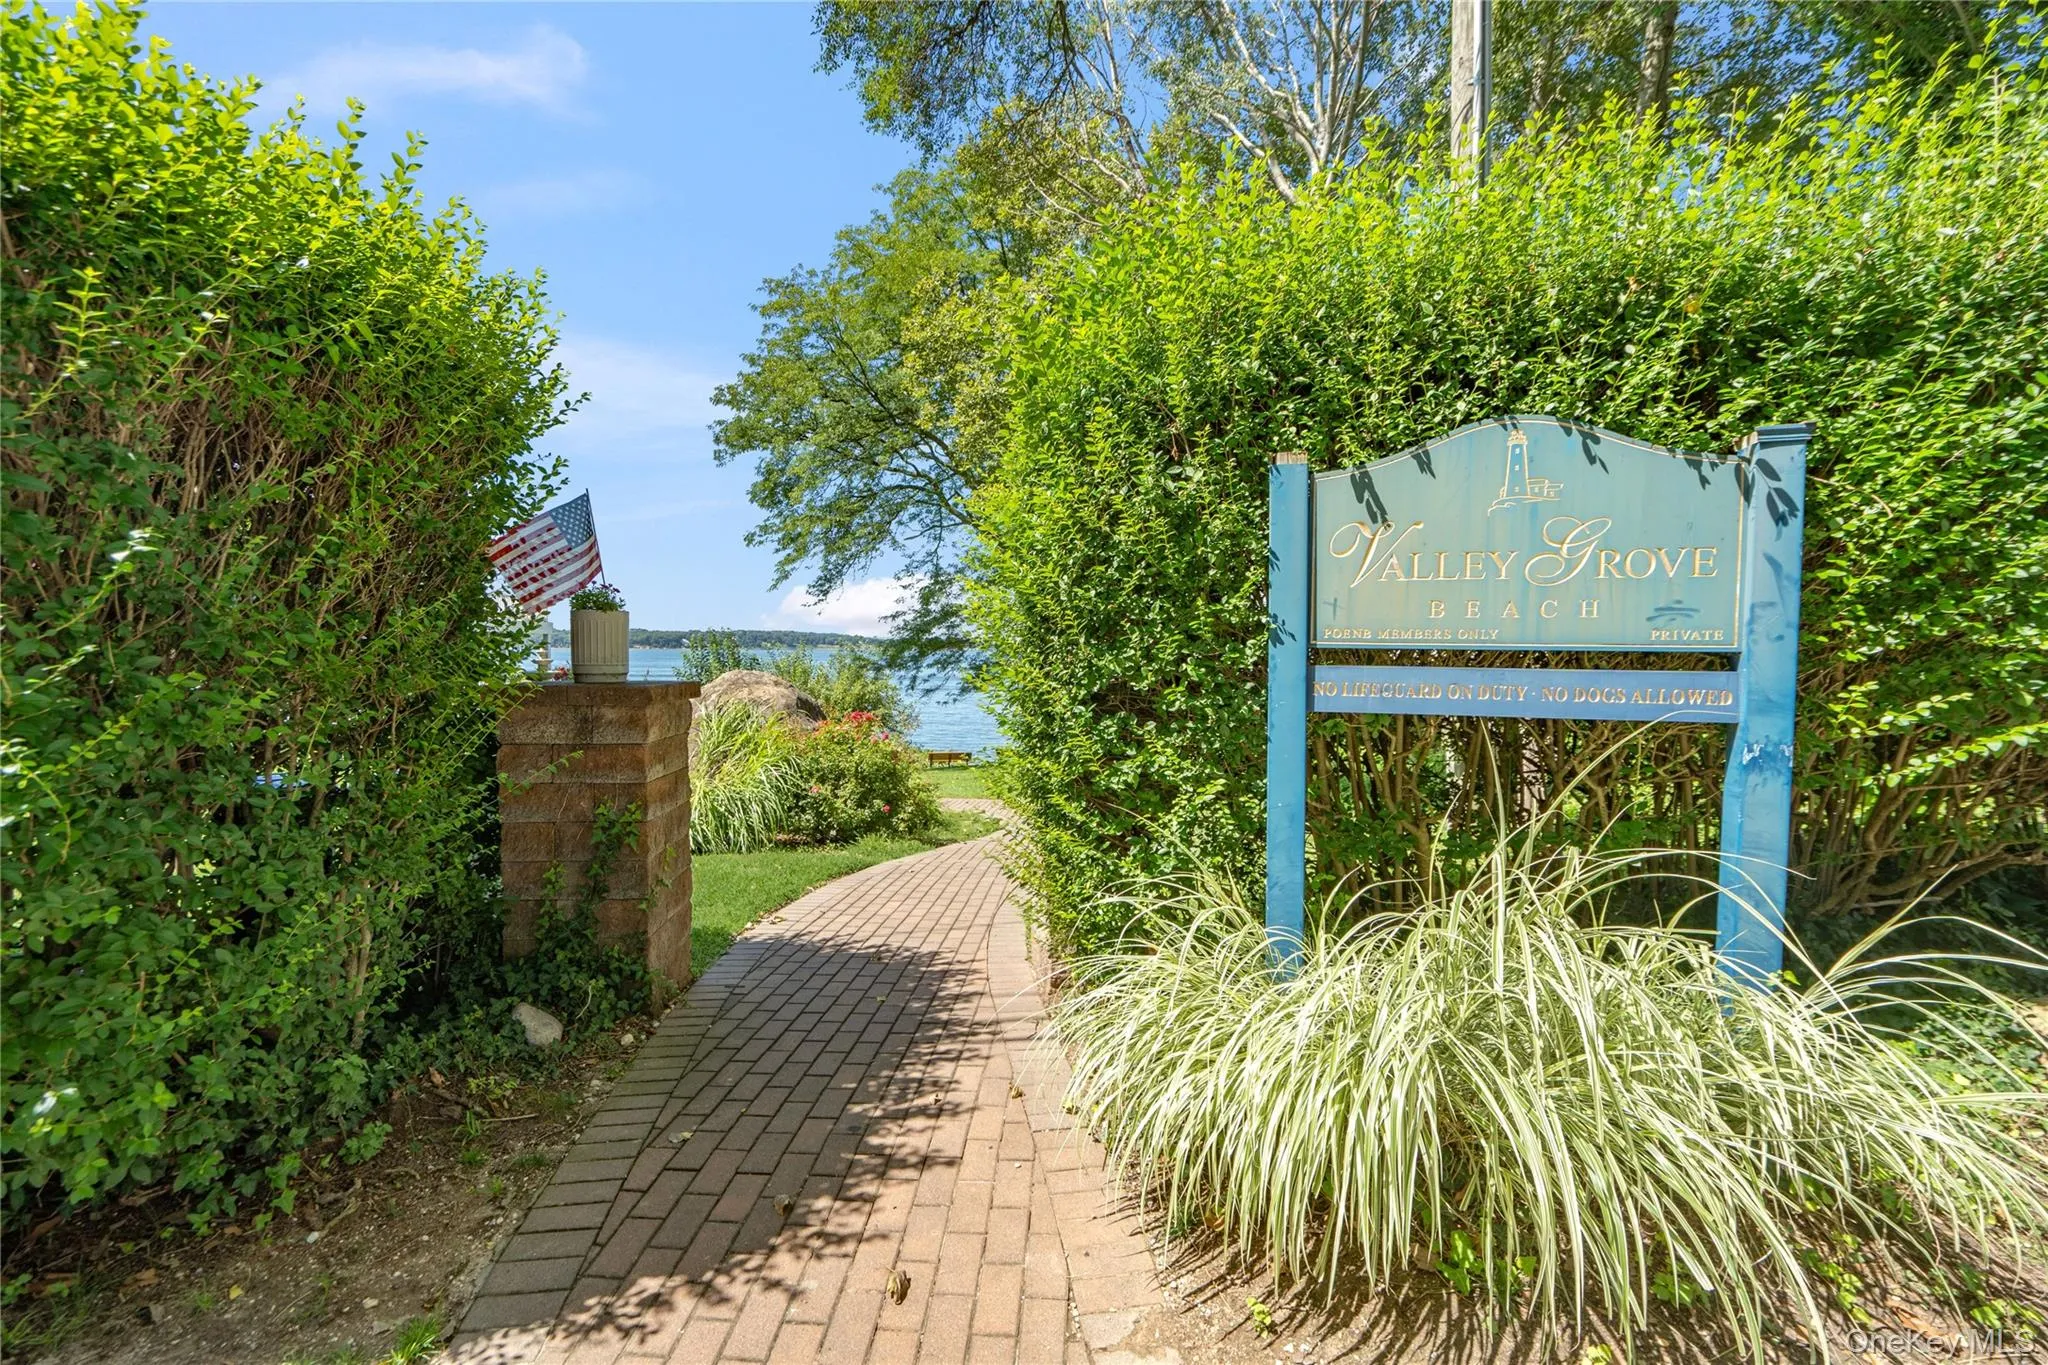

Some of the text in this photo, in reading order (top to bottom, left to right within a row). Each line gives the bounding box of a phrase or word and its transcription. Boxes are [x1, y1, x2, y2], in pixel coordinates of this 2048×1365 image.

[1330, 516, 1718, 588] VALLEY GROVE
[1429, 600, 1600, 618] BEACH
[1377, 629, 1452, 640] MEMBERS
[1457, 629, 1499, 640] ONLY
[1650, 629, 1724, 641] PRIVATE
[1312, 682, 1734, 706] NO LIFEGUARD ON DUTY NO DOGS ALLOWED
